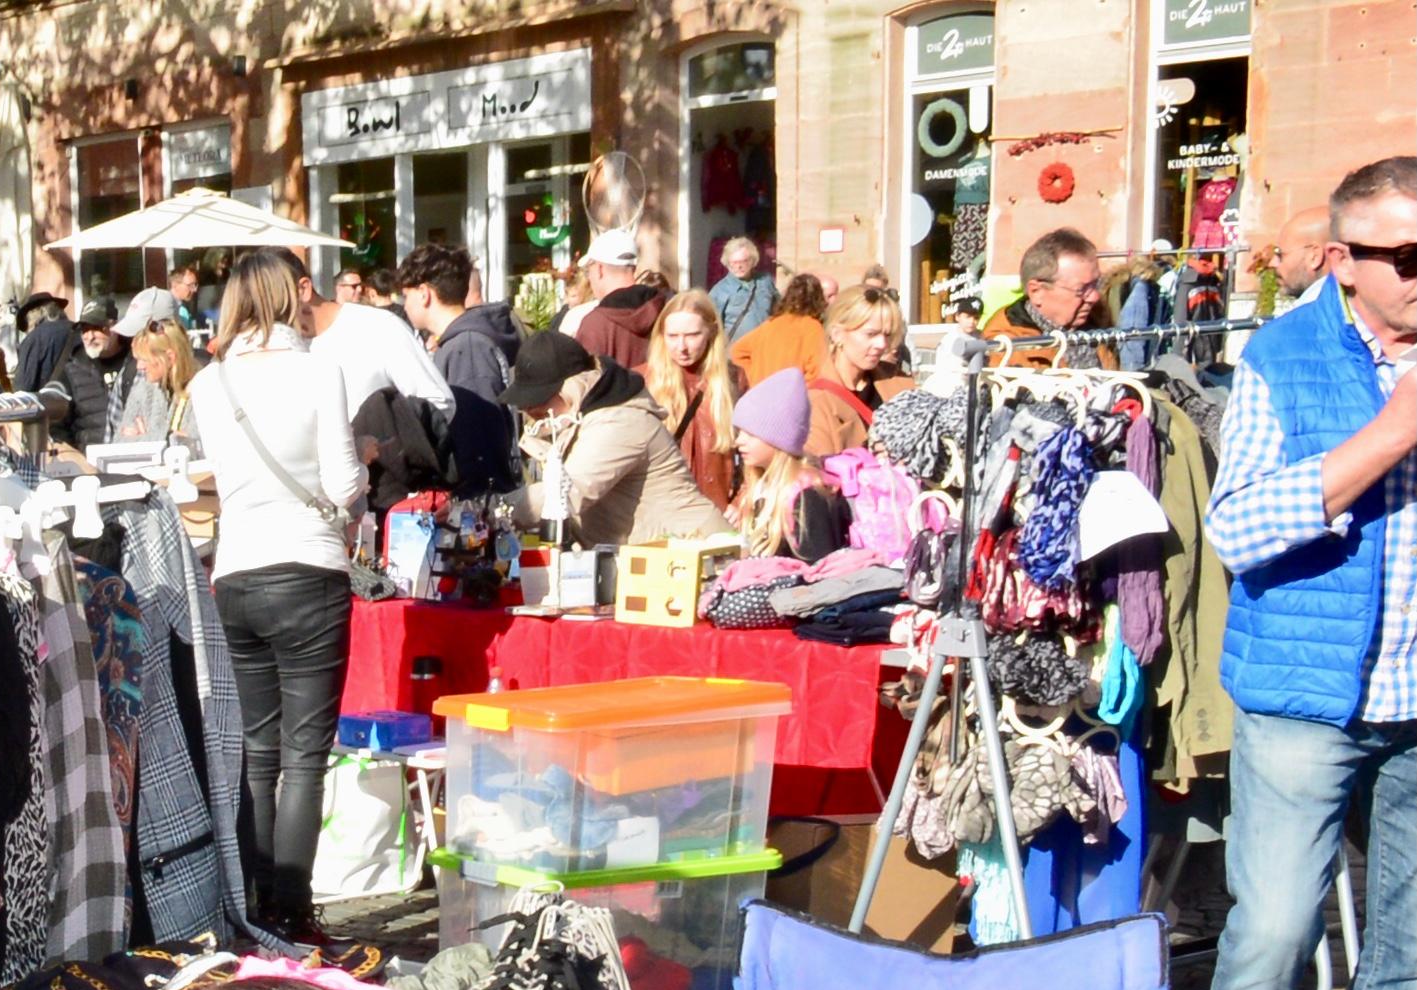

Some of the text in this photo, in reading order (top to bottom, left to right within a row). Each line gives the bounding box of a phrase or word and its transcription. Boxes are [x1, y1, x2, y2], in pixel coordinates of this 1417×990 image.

[1169, 9, 1188, 21] DIE
[1214, 2, 1246, 15] HAUT
[926, 42, 943, 53] DIE
[965, 35, 993, 48] HAUT
[346, 80, 539, 137] Bowl Mood
[1220, 142, 1230, 152] &
[1167, 154, 1241, 170] KINDERMODE
[924, 165, 988, 181] DAMENMODE
